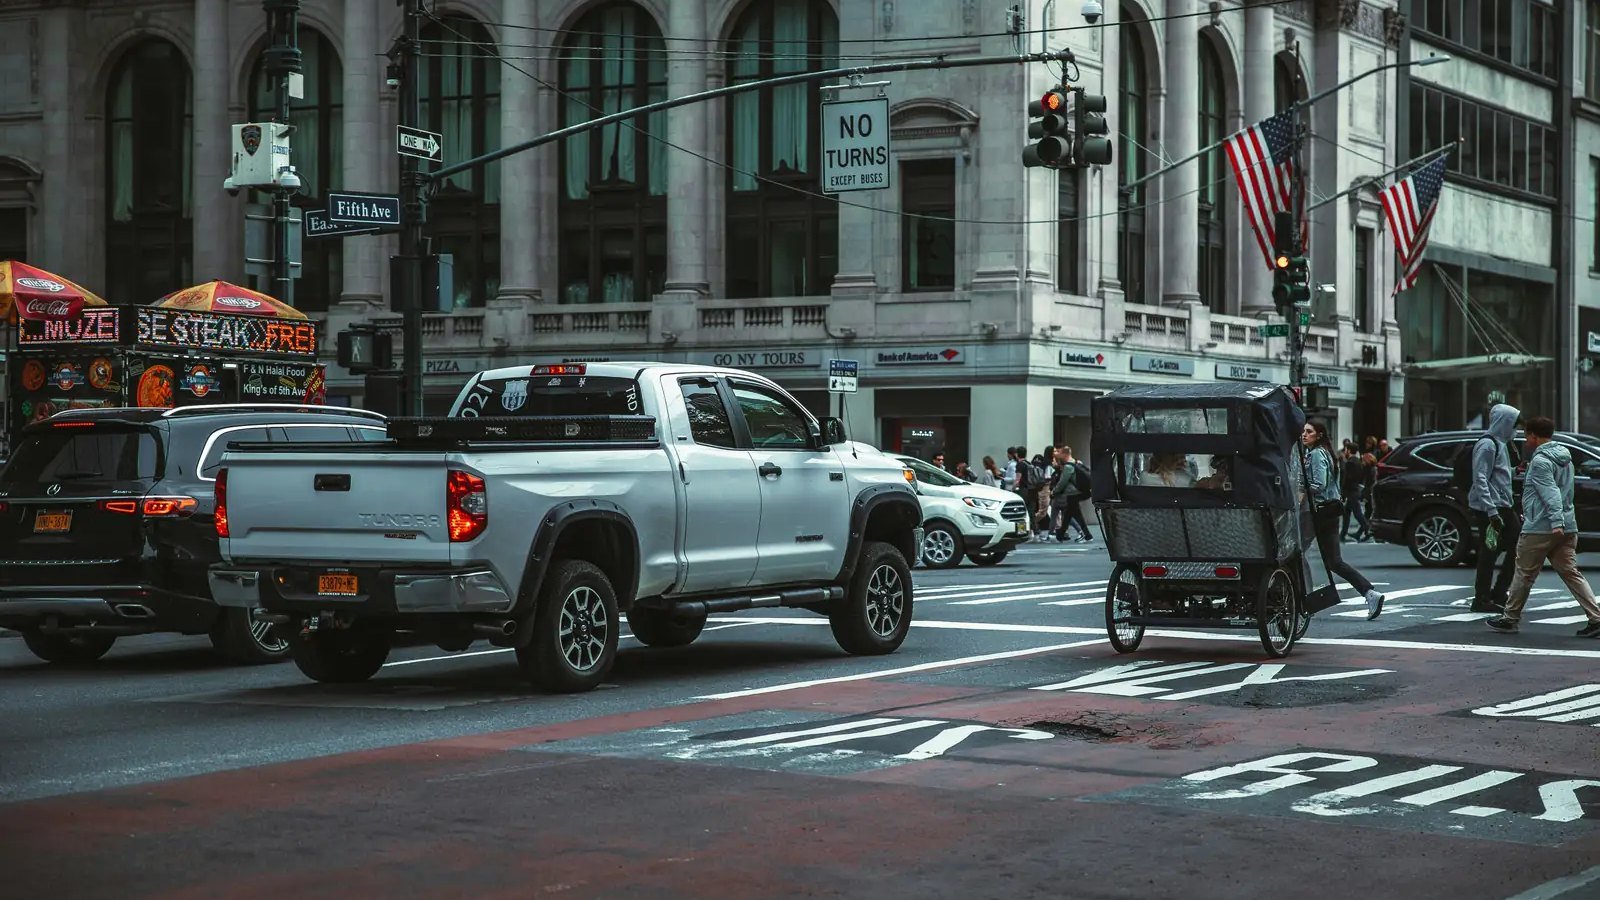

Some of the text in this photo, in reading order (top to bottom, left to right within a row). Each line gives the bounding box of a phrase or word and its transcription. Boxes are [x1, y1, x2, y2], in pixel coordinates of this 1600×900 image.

[840, 114, 872, 139] NO
[404, 136, 436, 151] ONE WAY
[826, 146, 887, 168] TURNS
[831, 173, 883, 186] EXCEPT BUSES
[337, 201, 391, 218] Fifth Ave
[310, 216, 338, 231] Eas
[713, 352, 805, 366] GO NY TOURS
[877, 351, 938, 362] Bank of America
[243, 365, 306, 377] F & N Halal Food
[426, 360, 460, 371] PIZZA
[1230, 366, 1245, 378] DECO
[243, 383, 306, 396] King's of 5th Ave
[626, 384, 638, 411] TRD
[358, 513, 440, 527] TUNDRA
